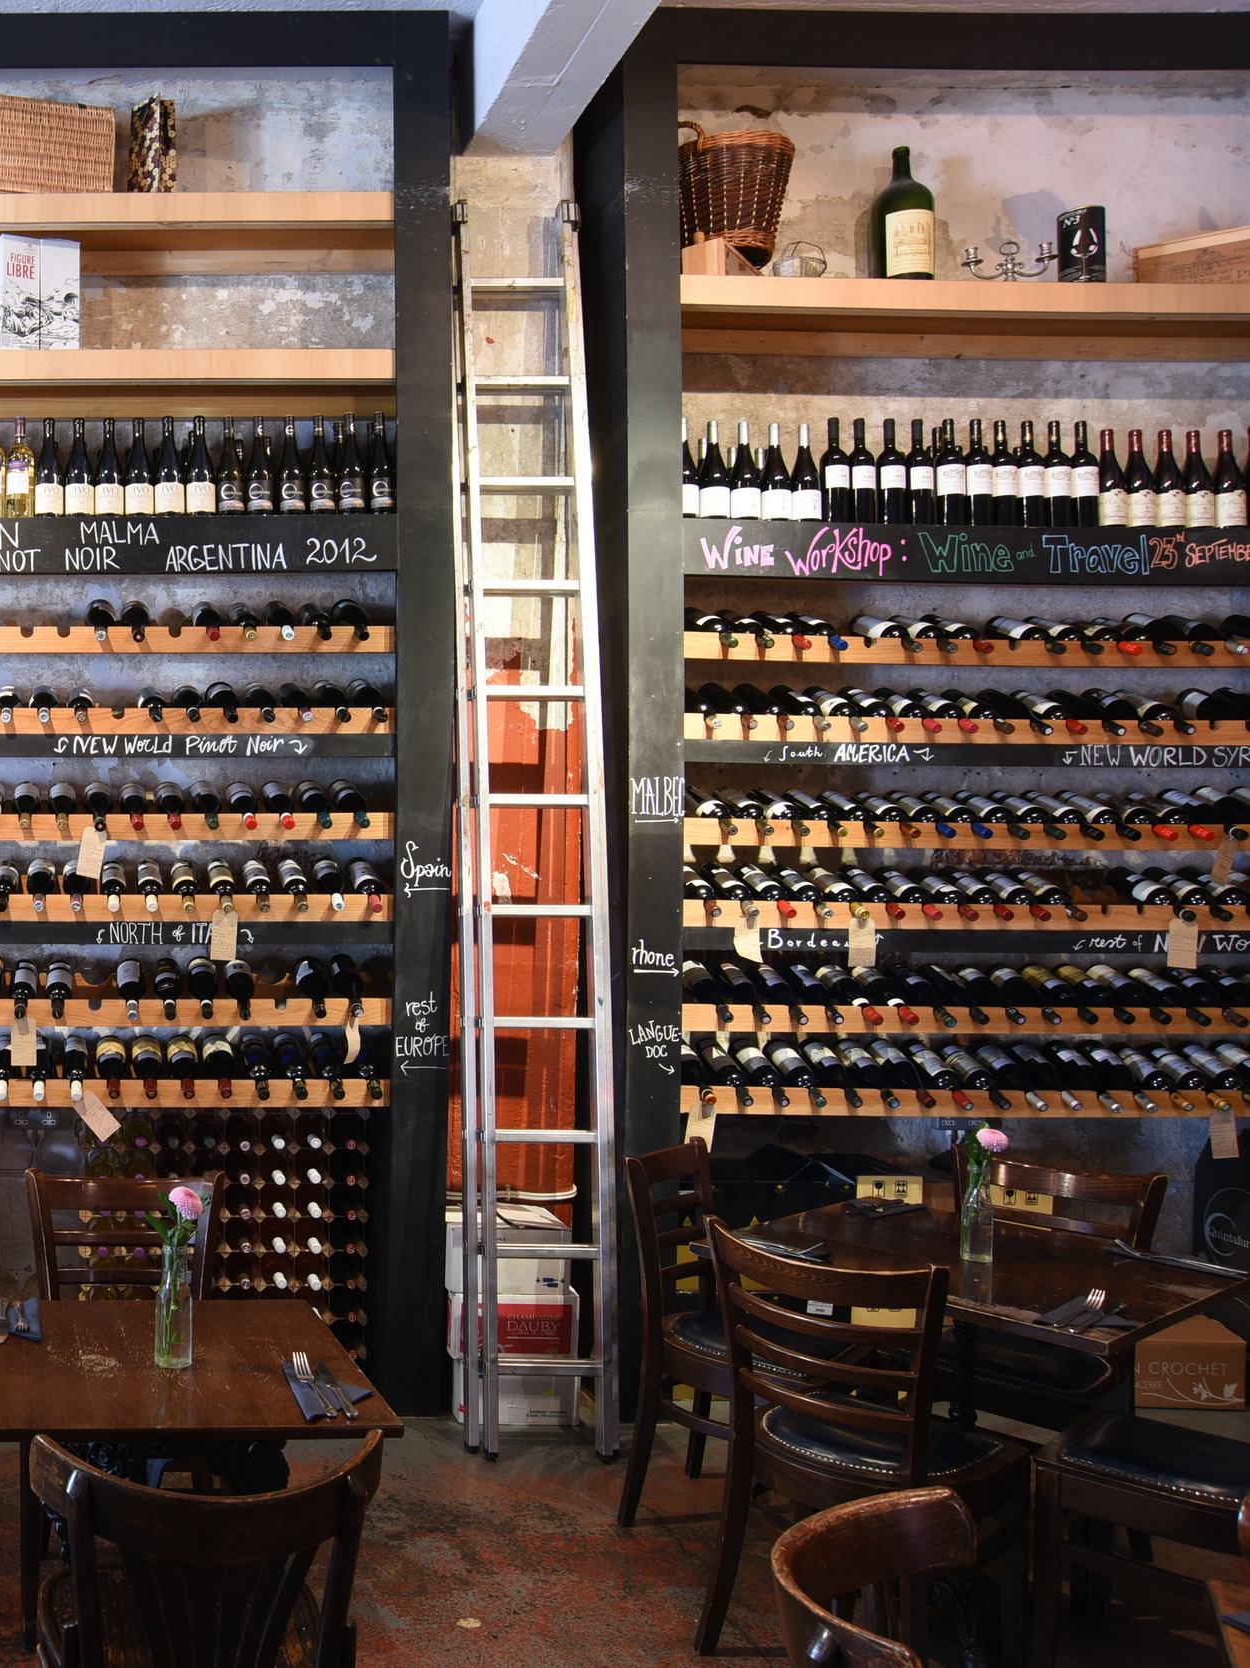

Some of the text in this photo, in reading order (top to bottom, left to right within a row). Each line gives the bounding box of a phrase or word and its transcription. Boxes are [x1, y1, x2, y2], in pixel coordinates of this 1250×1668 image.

[10, 252, 36, 266] FIGURE
[6, 261, 36, 280] LIBRE
[80, 520, 160, 545] MALMA
[65, 546, 120, 571] NOIR
[165, 542, 288, 573] ARGENTINA
[306, 537, 378, 565] 2012
[918, 531, 1015, 574] Wine
[1016, 542, 1037, 561] and
[1042, 533, 1150, 576] Travel
[72, 734, 118, 754] NEW
[185, 735, 238, 755] Pinot
[246, 735, 285, 756] Noir
[778, 743, 911, 763] South AMERICA
[1079, 744, 1122, 767] NEW
[1129, 745, 1208, 767] WORLD
[630, 776, 685, 817] MALBEC
[400, 840, 452, 887] Spain
[109, 922, 164, 945] NORTH
[171, 924, 186, 942] of
[767, 928, 849, 949] Bordea
[1088, 933, 1127, 949] rest
[1132, 934, 1143, 952] of
[631, 939, 676, 967] rhone
[405, 990, 438, 1017] rest
[415, 1017, 430, 1033] of
[395, 1033, 450, 1058] EUROPE
[645, 1045, 668, 1059] DOC
[506, 1313, 561, 1321] CHAMPAGNE
[506, 1320, 561, 1333] DAUBY
[1148, 1361, 1229, 1376] CROCHET
